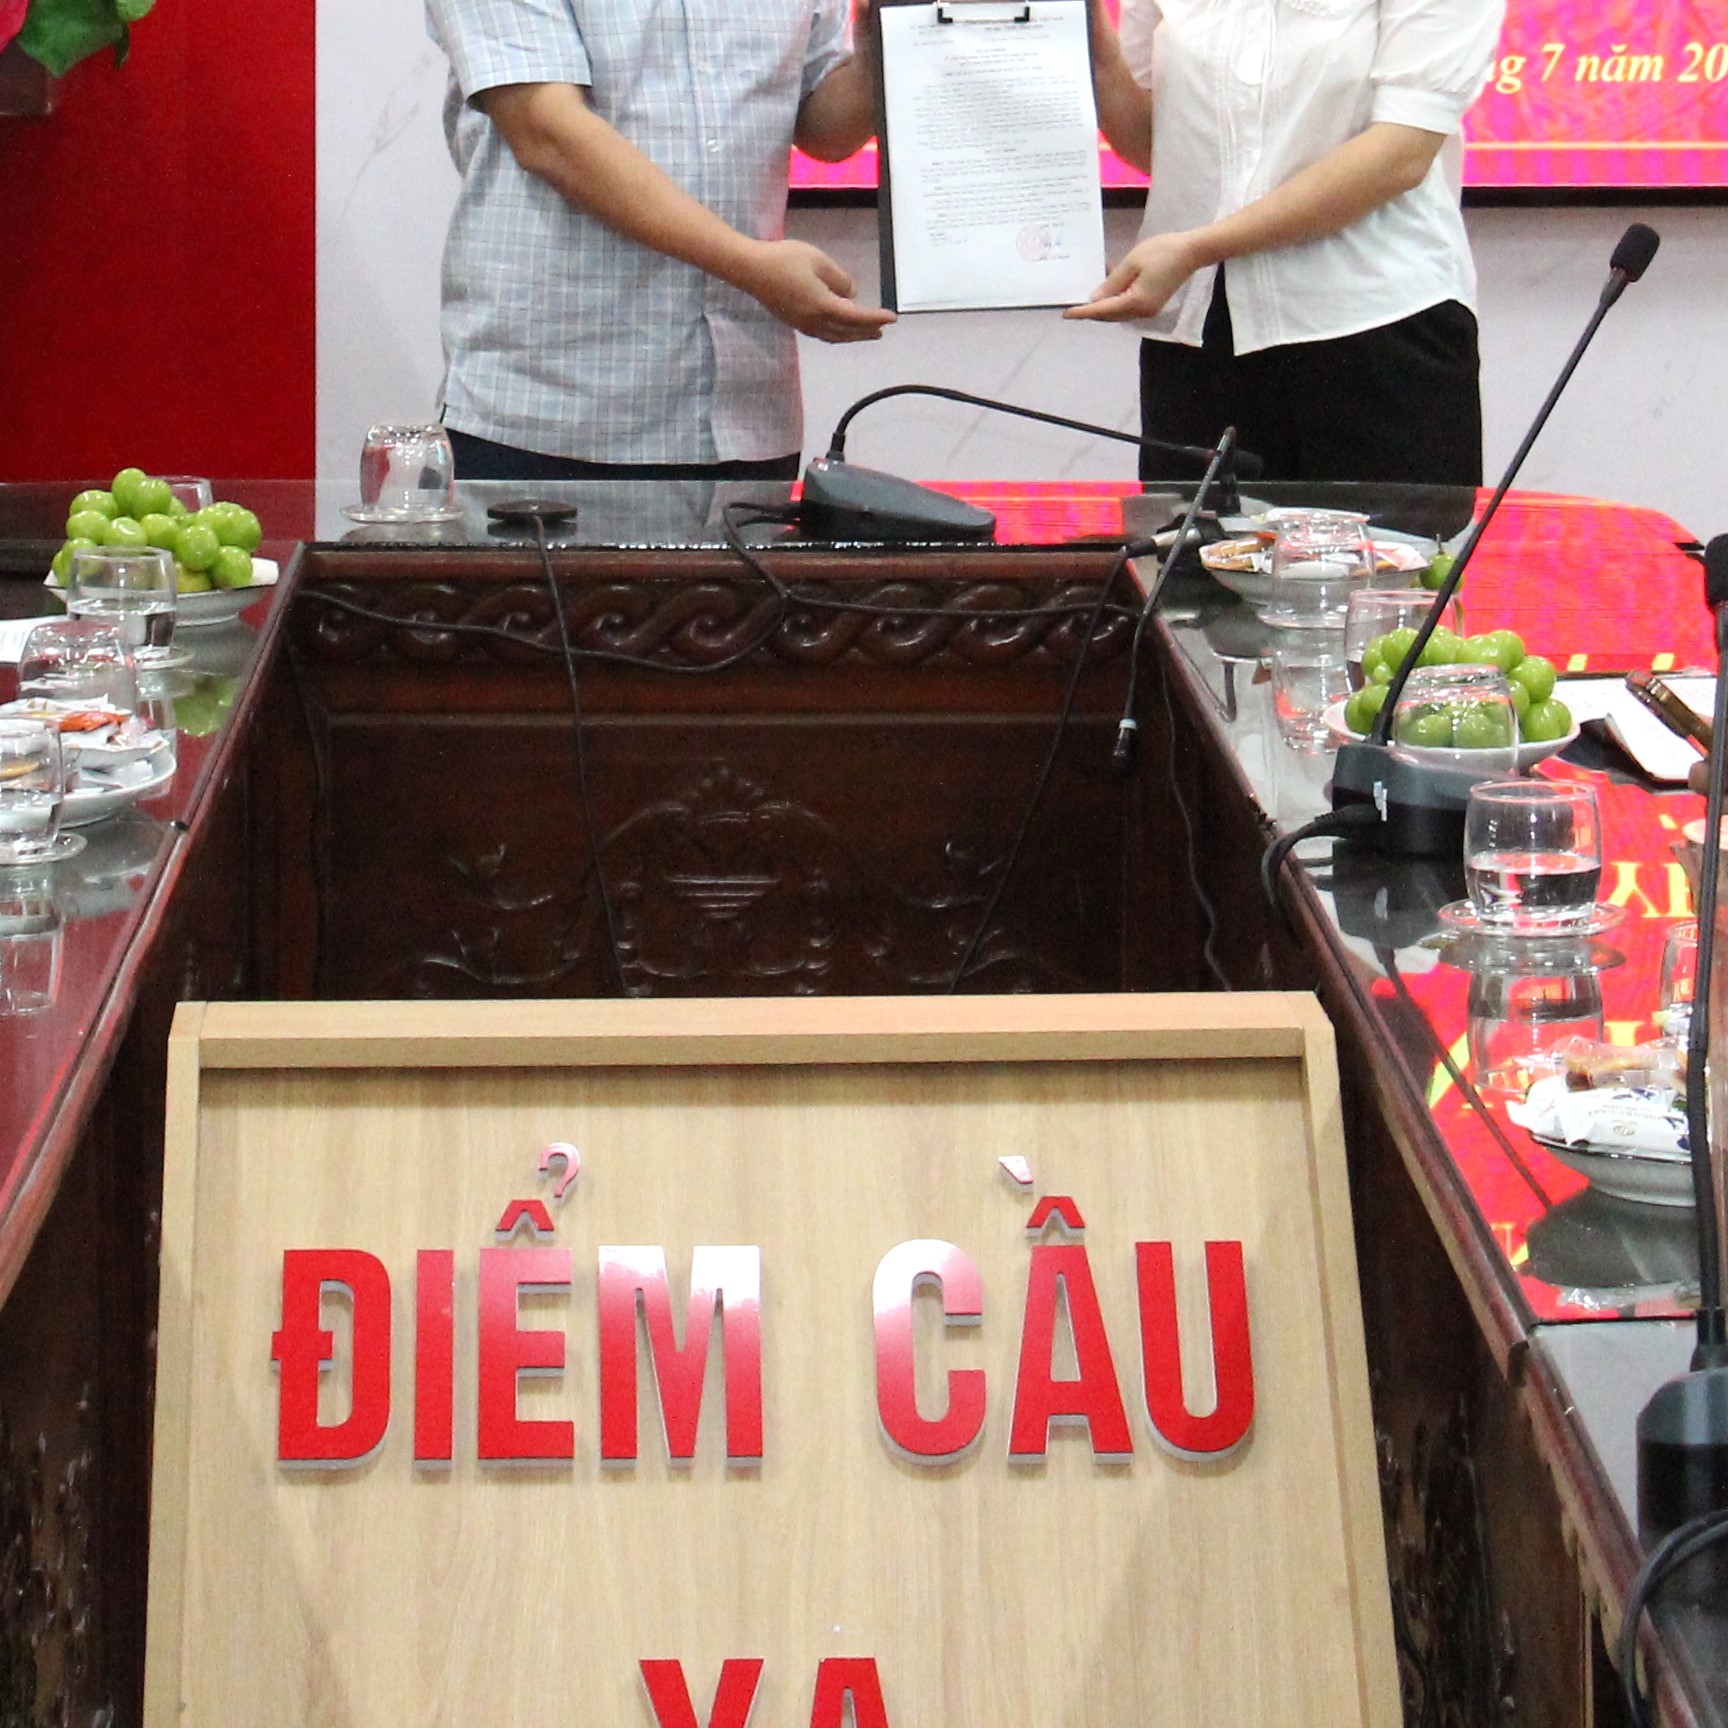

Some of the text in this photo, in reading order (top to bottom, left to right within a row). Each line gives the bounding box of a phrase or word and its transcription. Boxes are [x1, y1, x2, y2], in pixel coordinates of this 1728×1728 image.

[1540, 41, 1566, 82] 7
[1574, 42, 1664, 83] năm
[271, 1141, 1256, 1468] ĐIỂM CẦU
